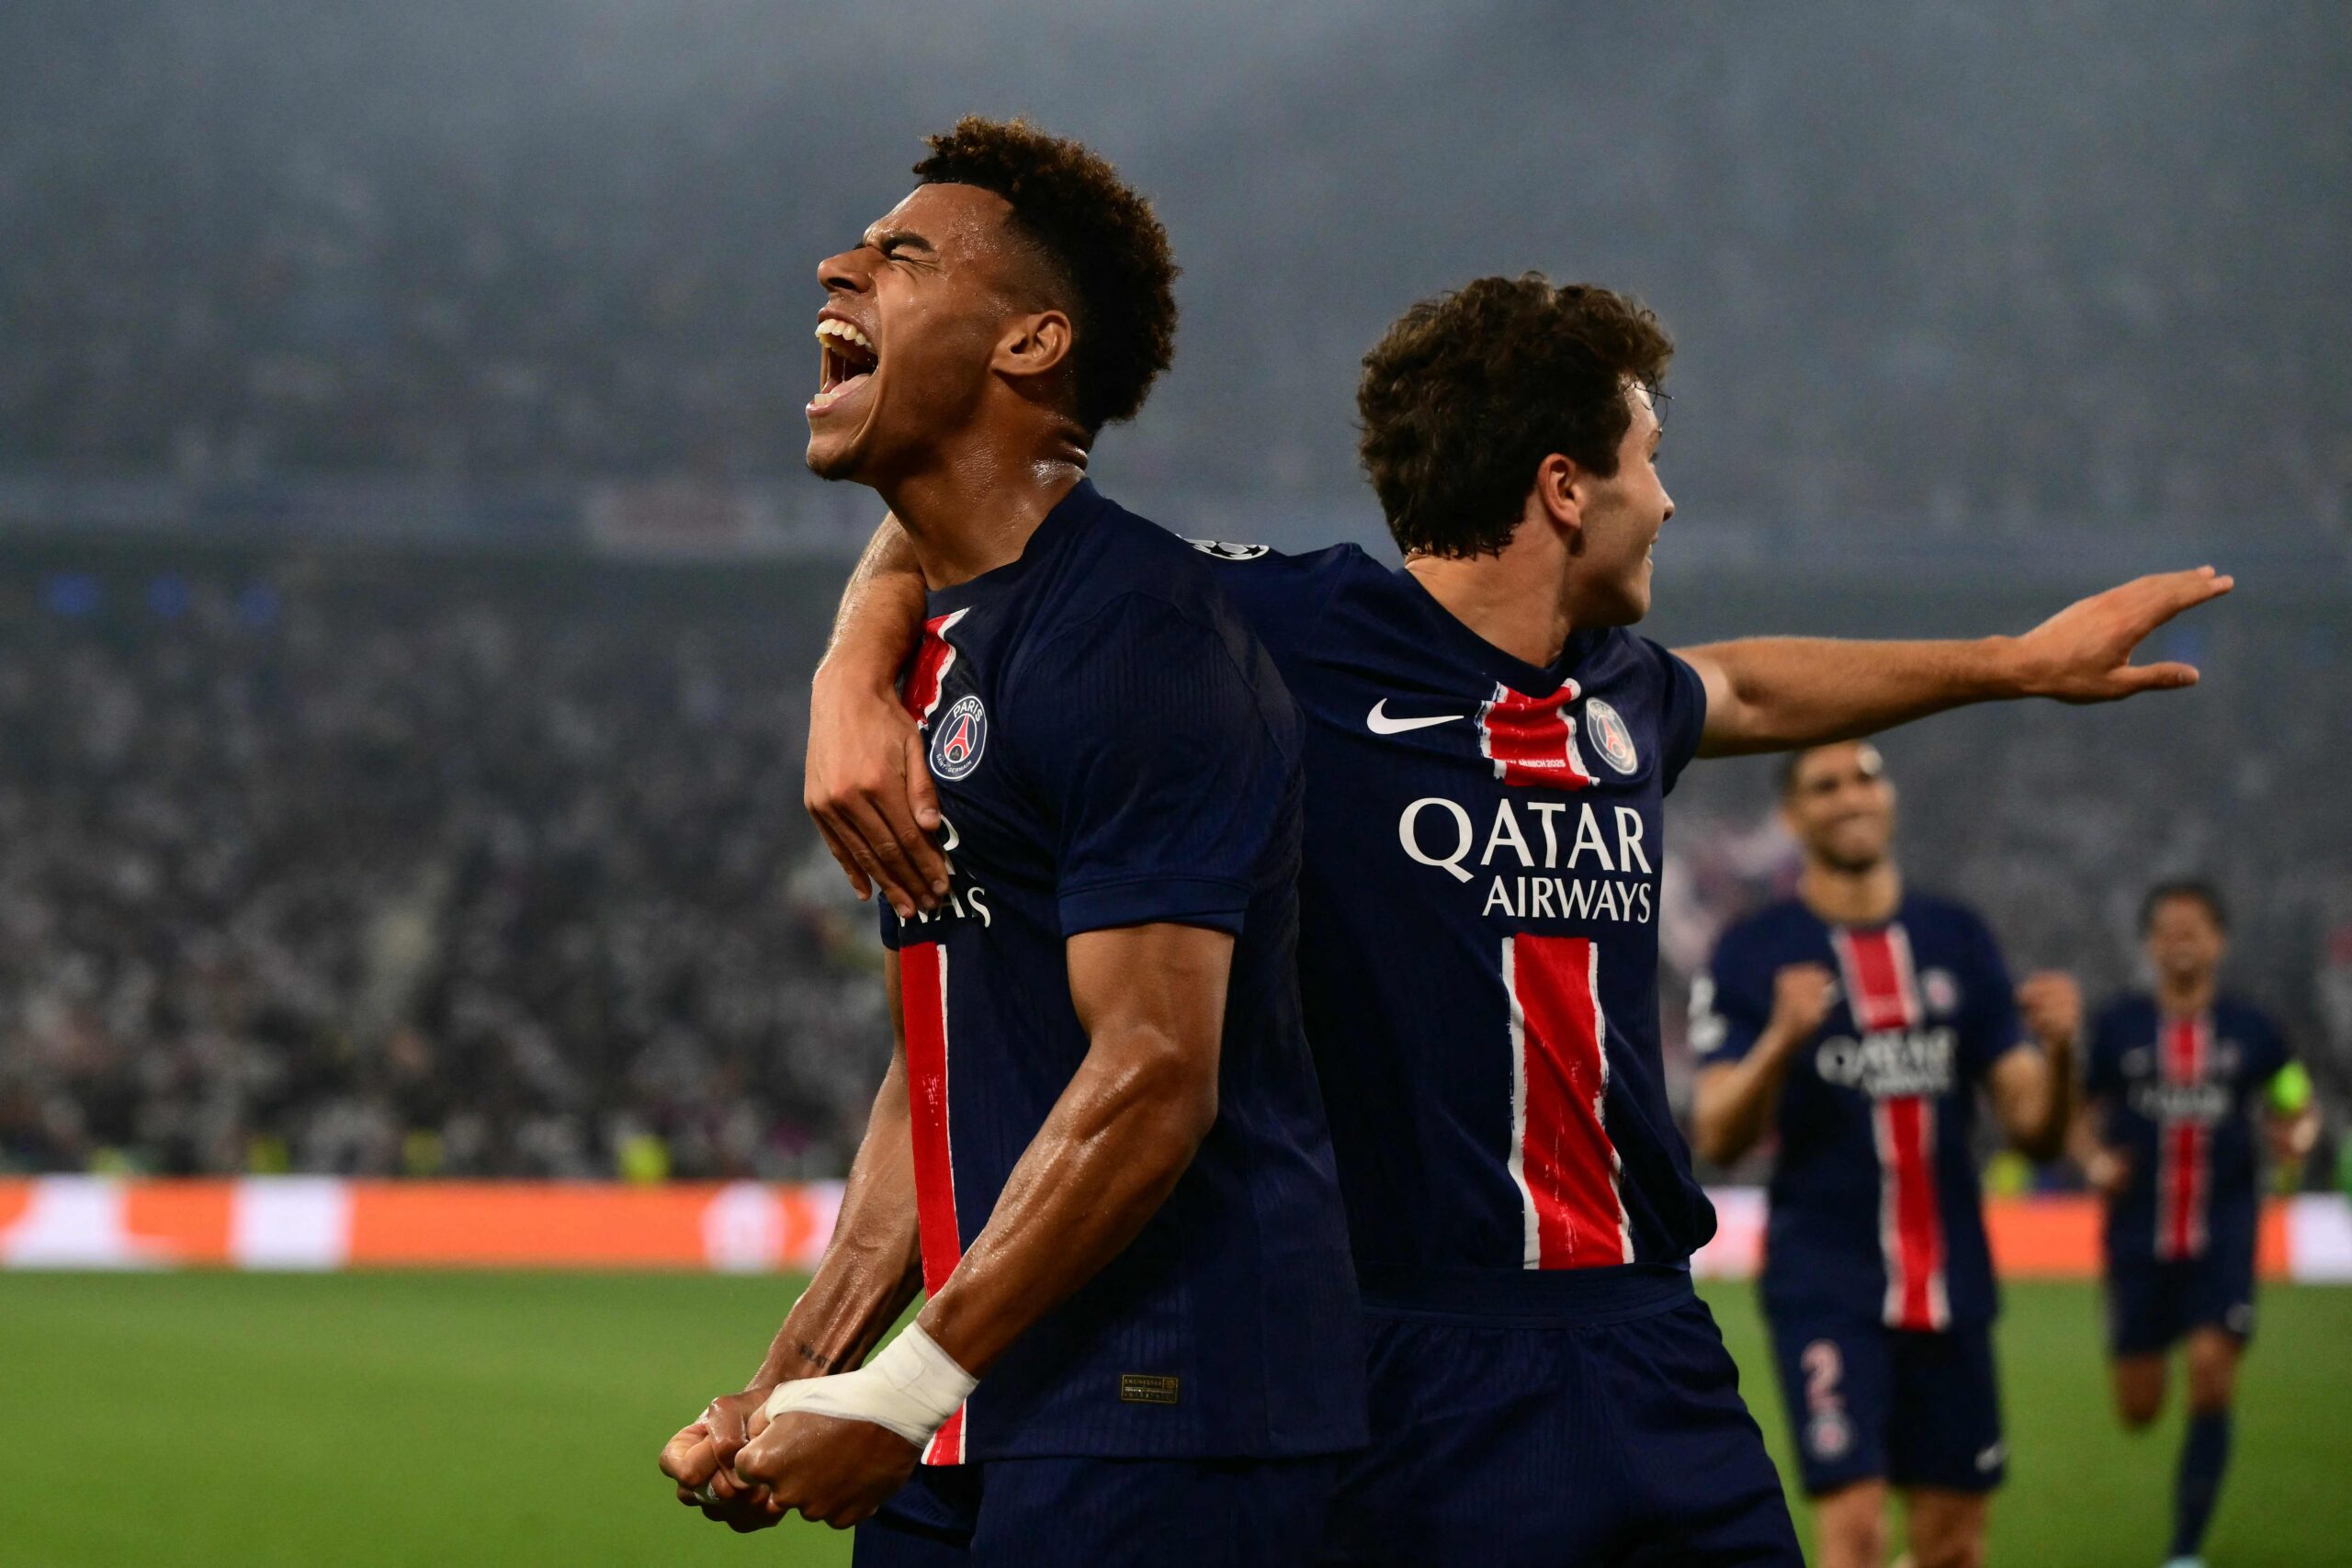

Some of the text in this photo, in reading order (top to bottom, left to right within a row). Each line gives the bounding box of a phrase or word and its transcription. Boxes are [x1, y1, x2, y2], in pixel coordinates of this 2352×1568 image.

[953, 700, 983, 722] PARIS
[1545, 759, 1566, 768] 2025
[1398, 797, 1652, 883] QATAR
[1481, 874, 1651, 924] AIRWAYS
